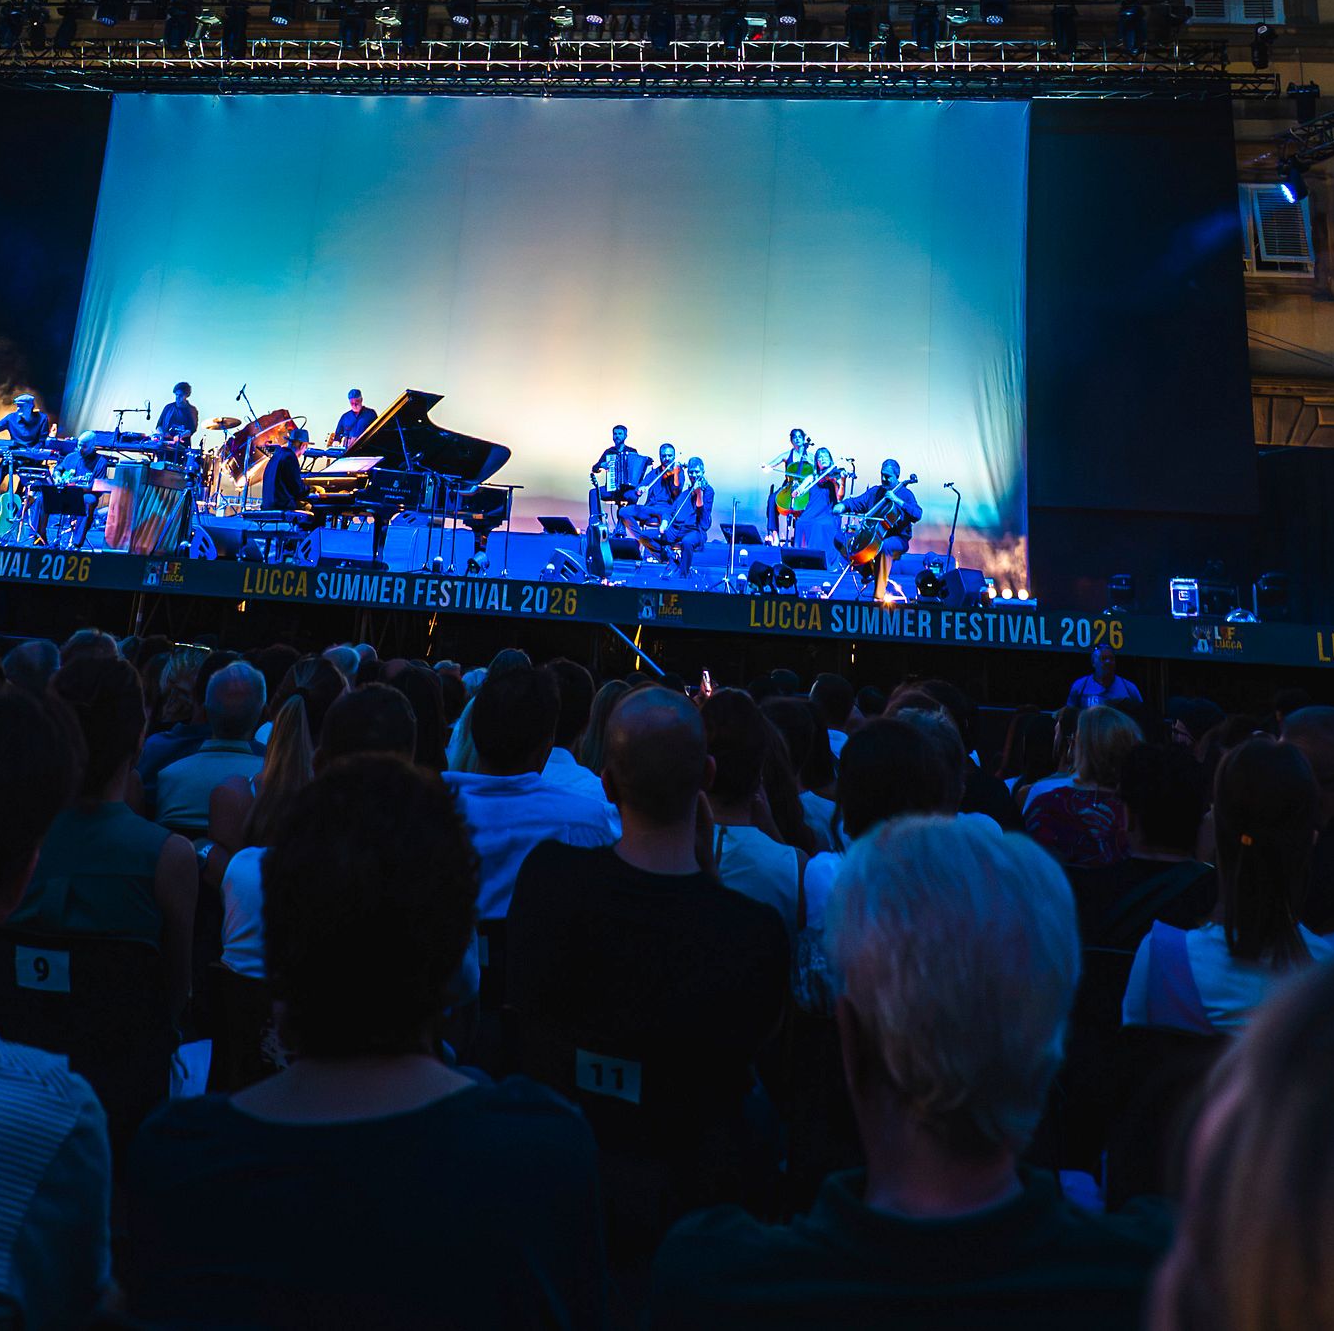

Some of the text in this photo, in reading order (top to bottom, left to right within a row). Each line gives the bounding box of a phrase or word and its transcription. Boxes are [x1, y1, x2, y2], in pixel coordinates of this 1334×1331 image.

[38, 553, 91, 583] 2026
[243, 568, 578, 616] LUCCA SUMMER FESTIVAL 2026
[750, 600, 1124, 650] LUCCA SUMMER FESTIVAL 2026
[34, 956, 49, 982] 9
[589, 1063, 623, 1089] 11
